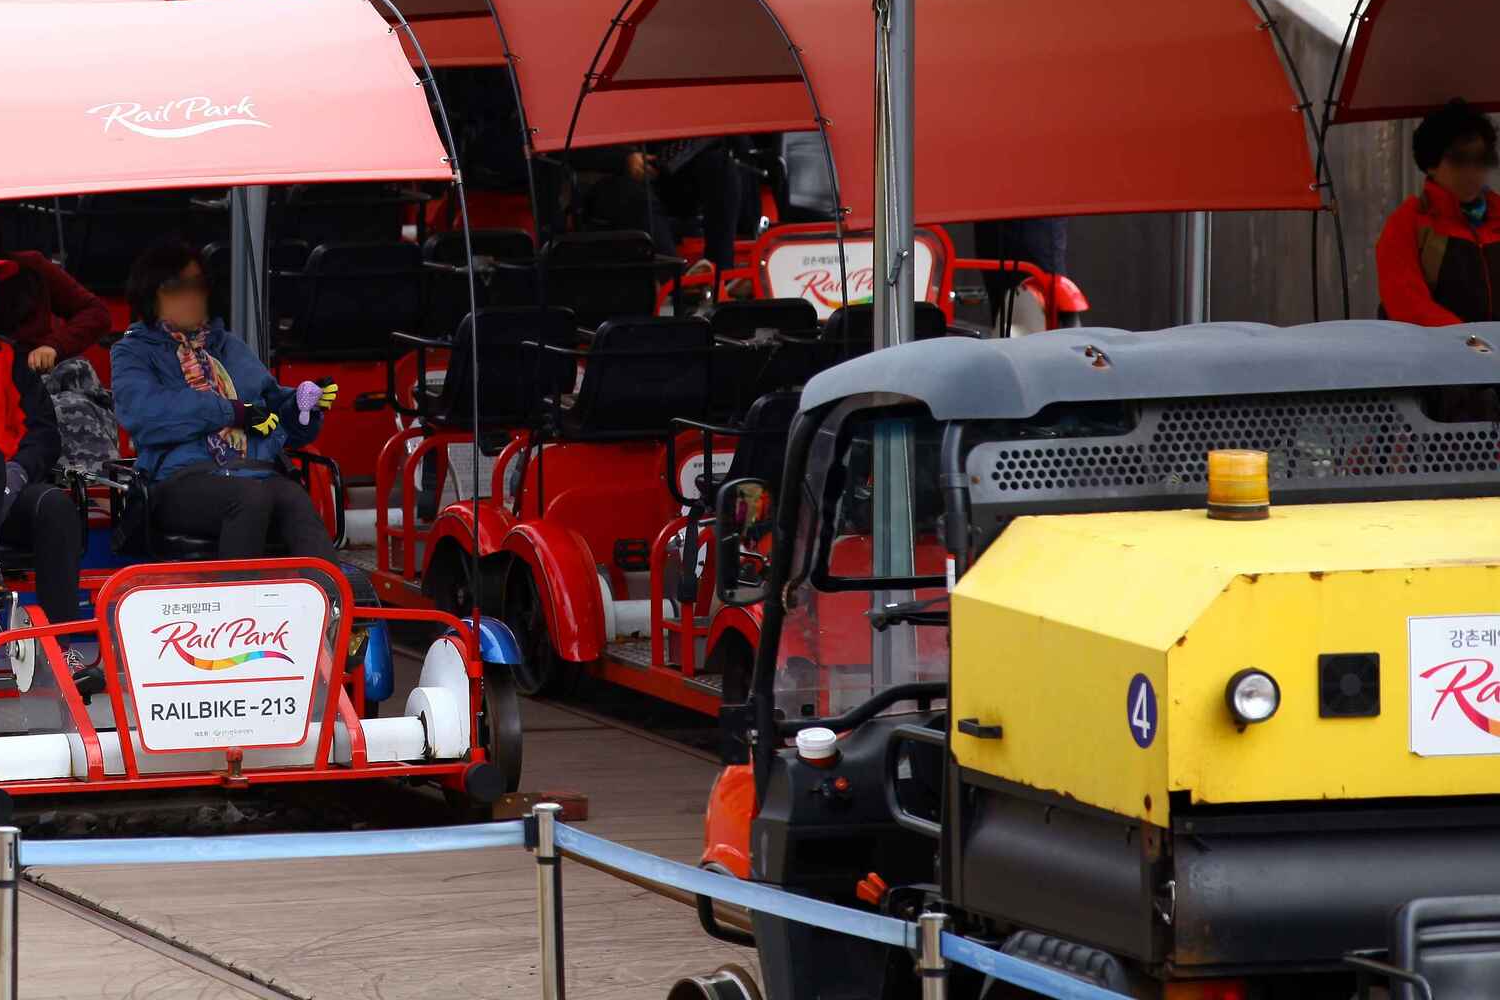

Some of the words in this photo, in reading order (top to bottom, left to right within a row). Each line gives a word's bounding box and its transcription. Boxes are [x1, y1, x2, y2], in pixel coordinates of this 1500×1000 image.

[85, 101, 175, 134] Rail
[176, 96, 258, 120] Park
[161, 601, 221, 616] 강촌레일파크
[151, 620, 227, 664] Rail
[225, 617, 289, 650] Park
[1449, 629, 1500, 648] 강촌레
[1132, 682, 1151, 739] 4
